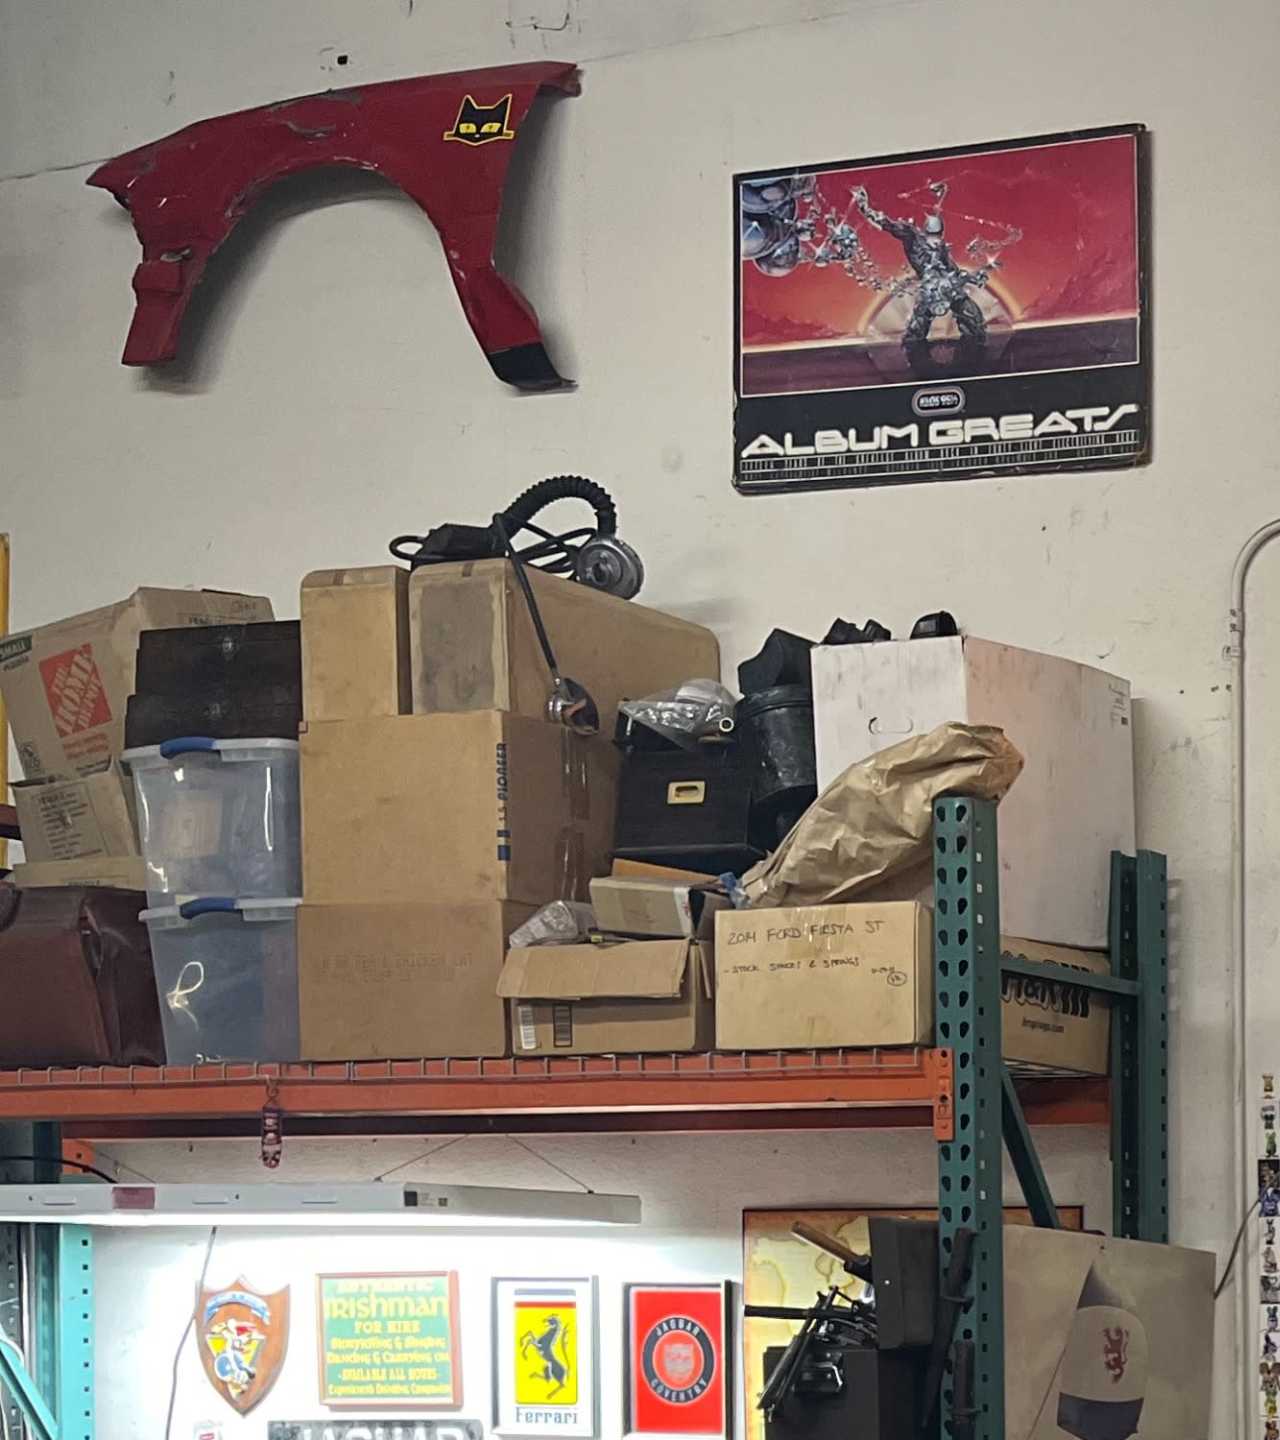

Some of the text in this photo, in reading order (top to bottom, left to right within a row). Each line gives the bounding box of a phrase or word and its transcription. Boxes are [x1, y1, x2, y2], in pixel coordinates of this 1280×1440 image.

[741, 402, 1138, 457] ALBUM GREATS
[766, 928, 801, 942] FORD
[810, 924, 854, 937] FIESTA
[864, 920, 886, 934] ST
[354, 1320, 421, 1334] FOR HIRE
[655, 1317, 701, 1337] JAGUAR
[649, 1377, 708, 1404] COVENTRY
[515, 1405, 578, 1425] Ferrari
